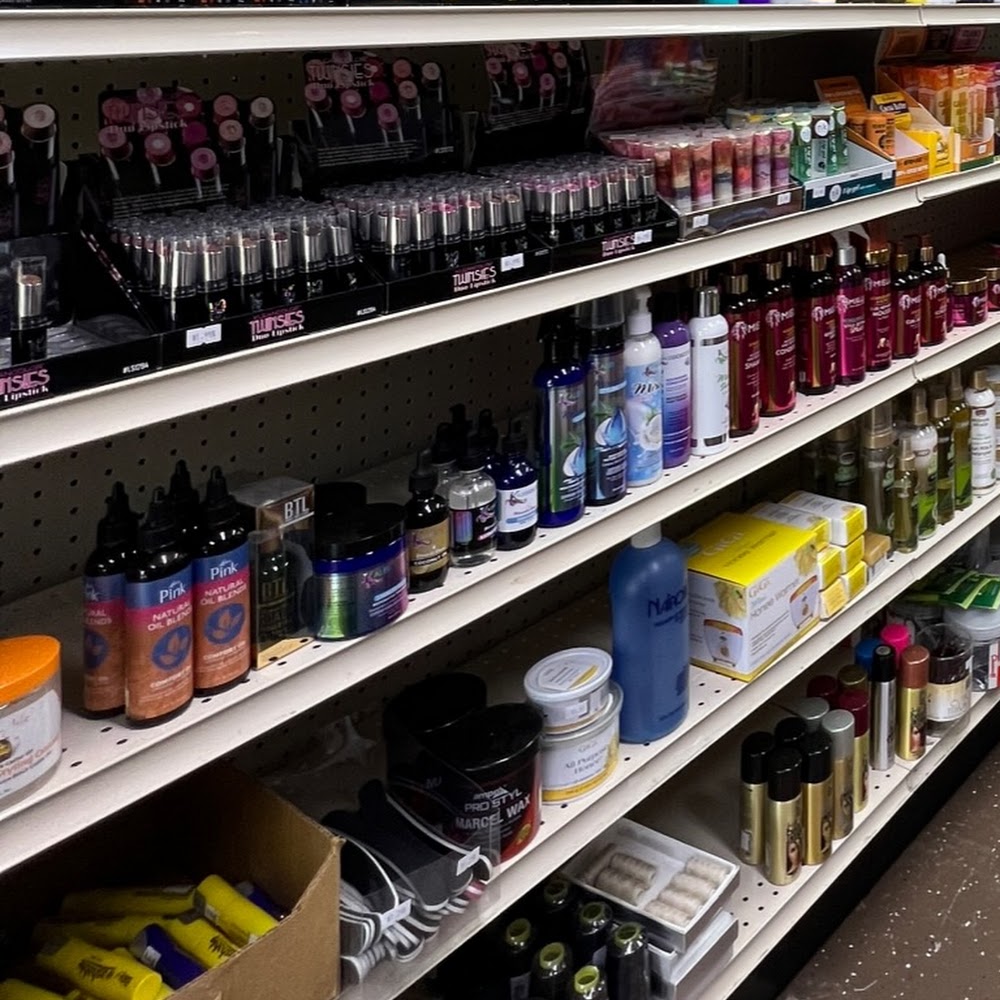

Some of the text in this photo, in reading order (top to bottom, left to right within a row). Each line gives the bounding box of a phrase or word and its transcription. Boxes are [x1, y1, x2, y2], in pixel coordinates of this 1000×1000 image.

[249, 310, 305, 335] TWINSIES
[272, 324, 304, 337] Lipstick
[284, 496, 310, 520] BTL
[210, 563, 239, 580] Pink
[159, 583, 187, 603] Pink
[204, 579, 244, 597] NATURAL
[200, 597, 215, 606] OIL
[147, 621, 165, 631] OIL
[456, 795, 531, 830] MARCEL WAX
[464, 801, 490, 813] PRO
